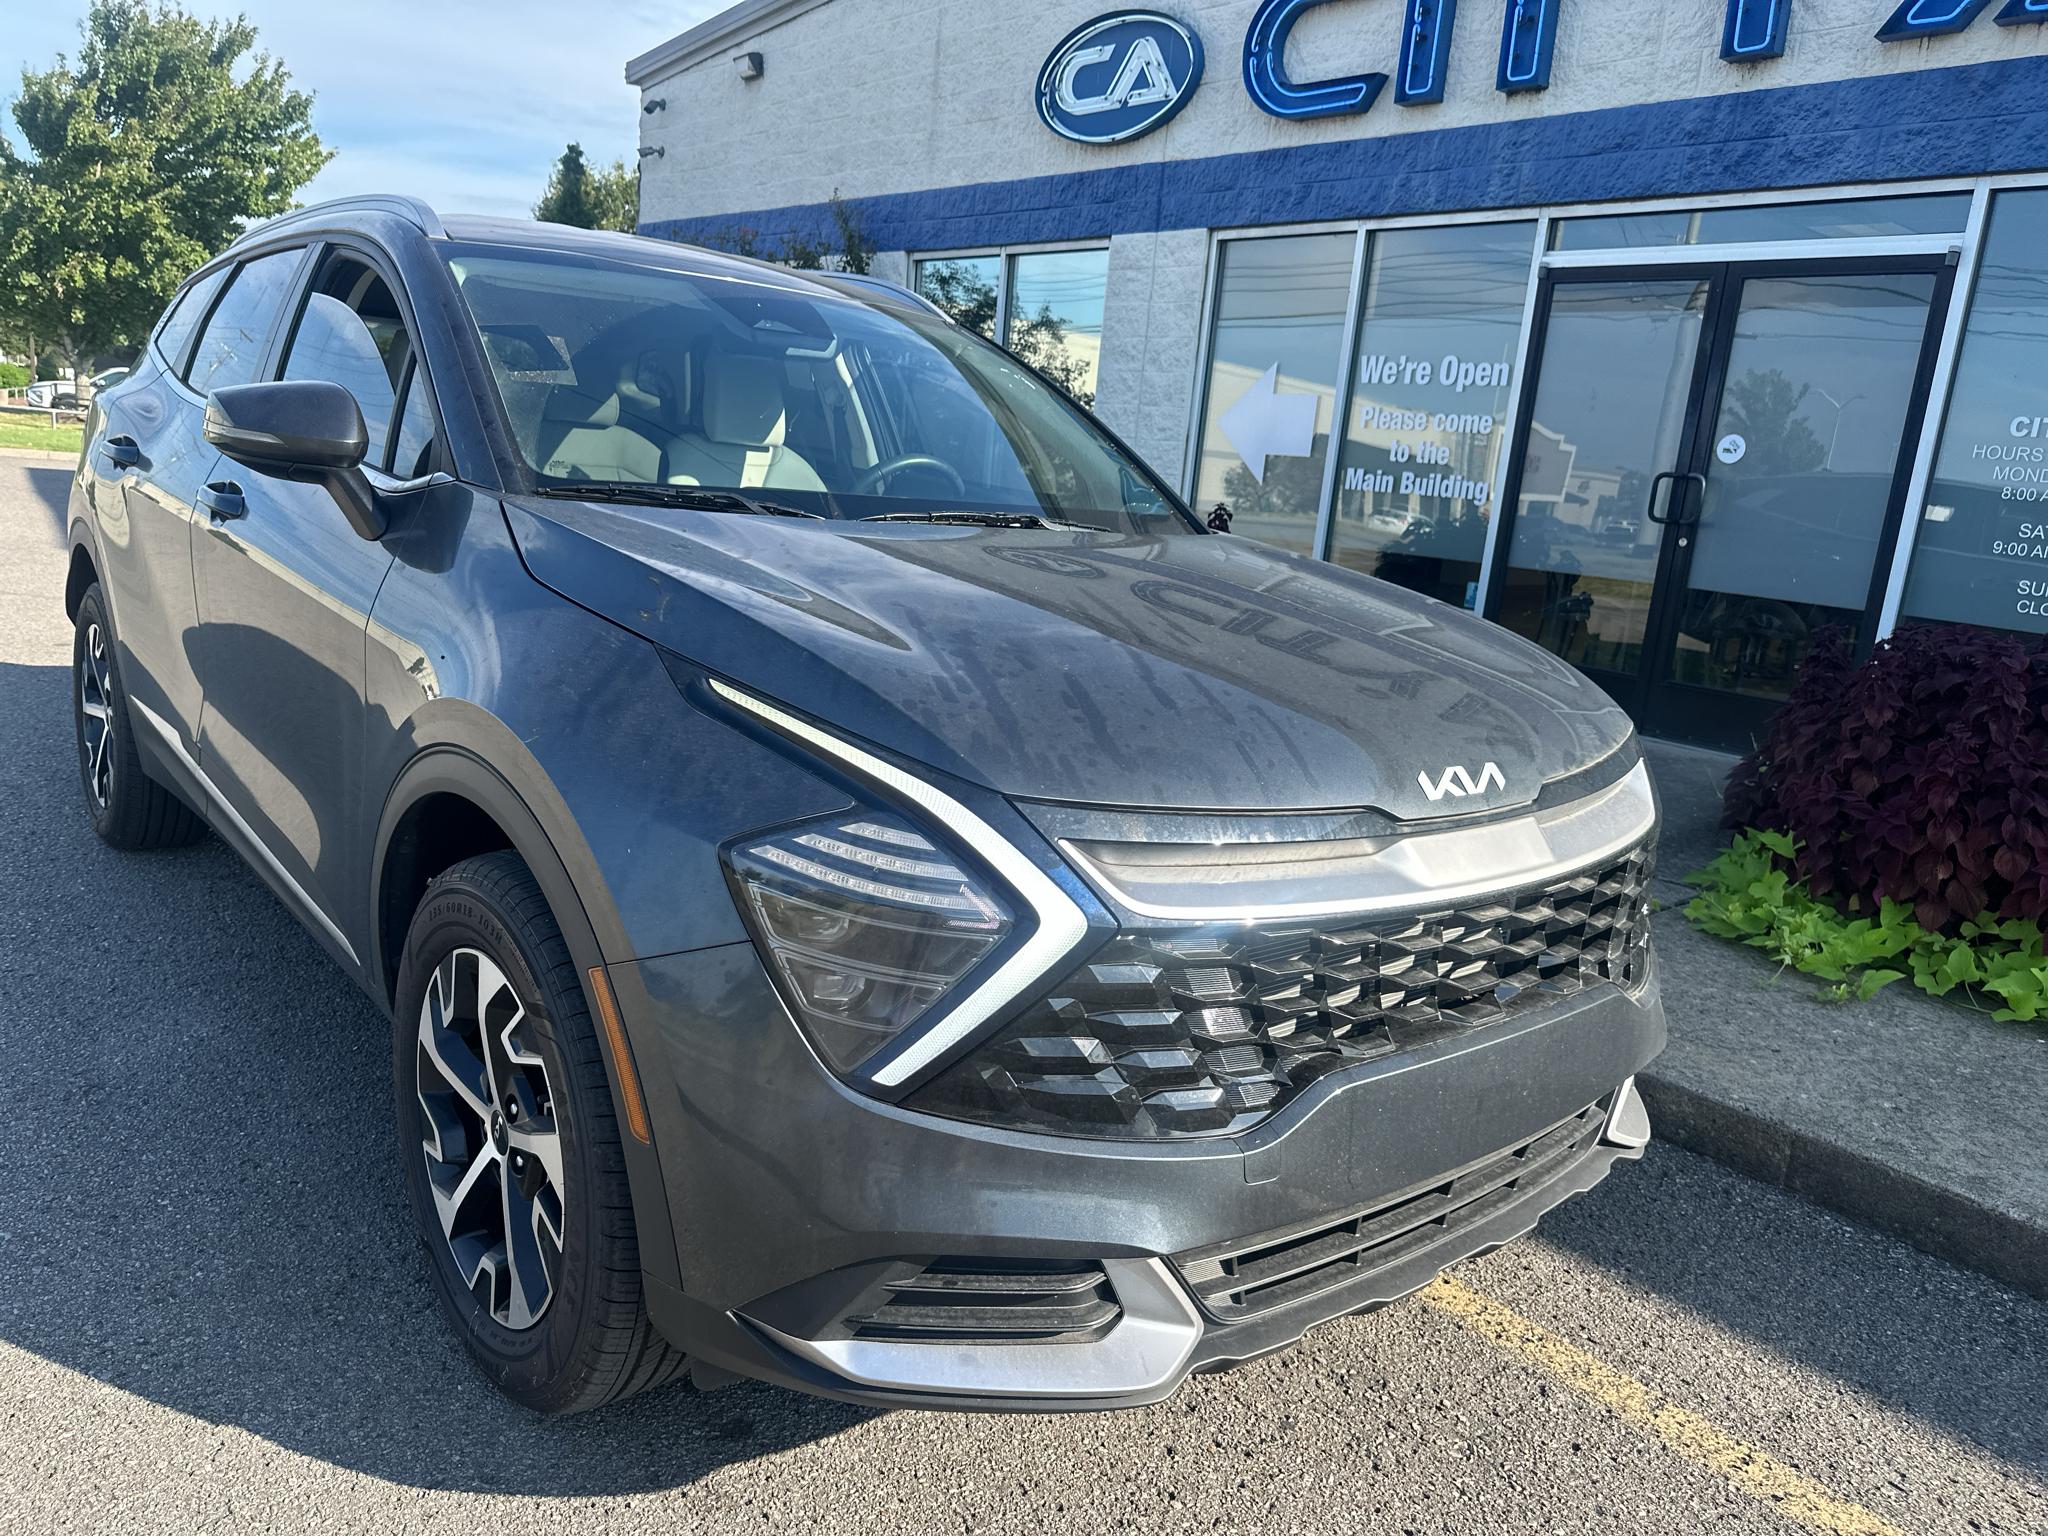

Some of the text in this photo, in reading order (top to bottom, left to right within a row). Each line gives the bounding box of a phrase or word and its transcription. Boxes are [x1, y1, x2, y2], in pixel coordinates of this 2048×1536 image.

[1360, 355, 1510, 392] We're Open
[1359, 407, 1493, 434] Please come
[1389, 440, 1450, 465] to the
[1972, 444, 2044, 462] HOURS
[1344, 467, 1489, 506] Main Building
[2001, 486, 2037, 501] 8:00
[2018, 523, 2048, 540] SA
[1992, 541, 2028, 557] 9:00
[2017, 580, 2048, 597] SU
[1417, 762, 1506, 801] KIA
